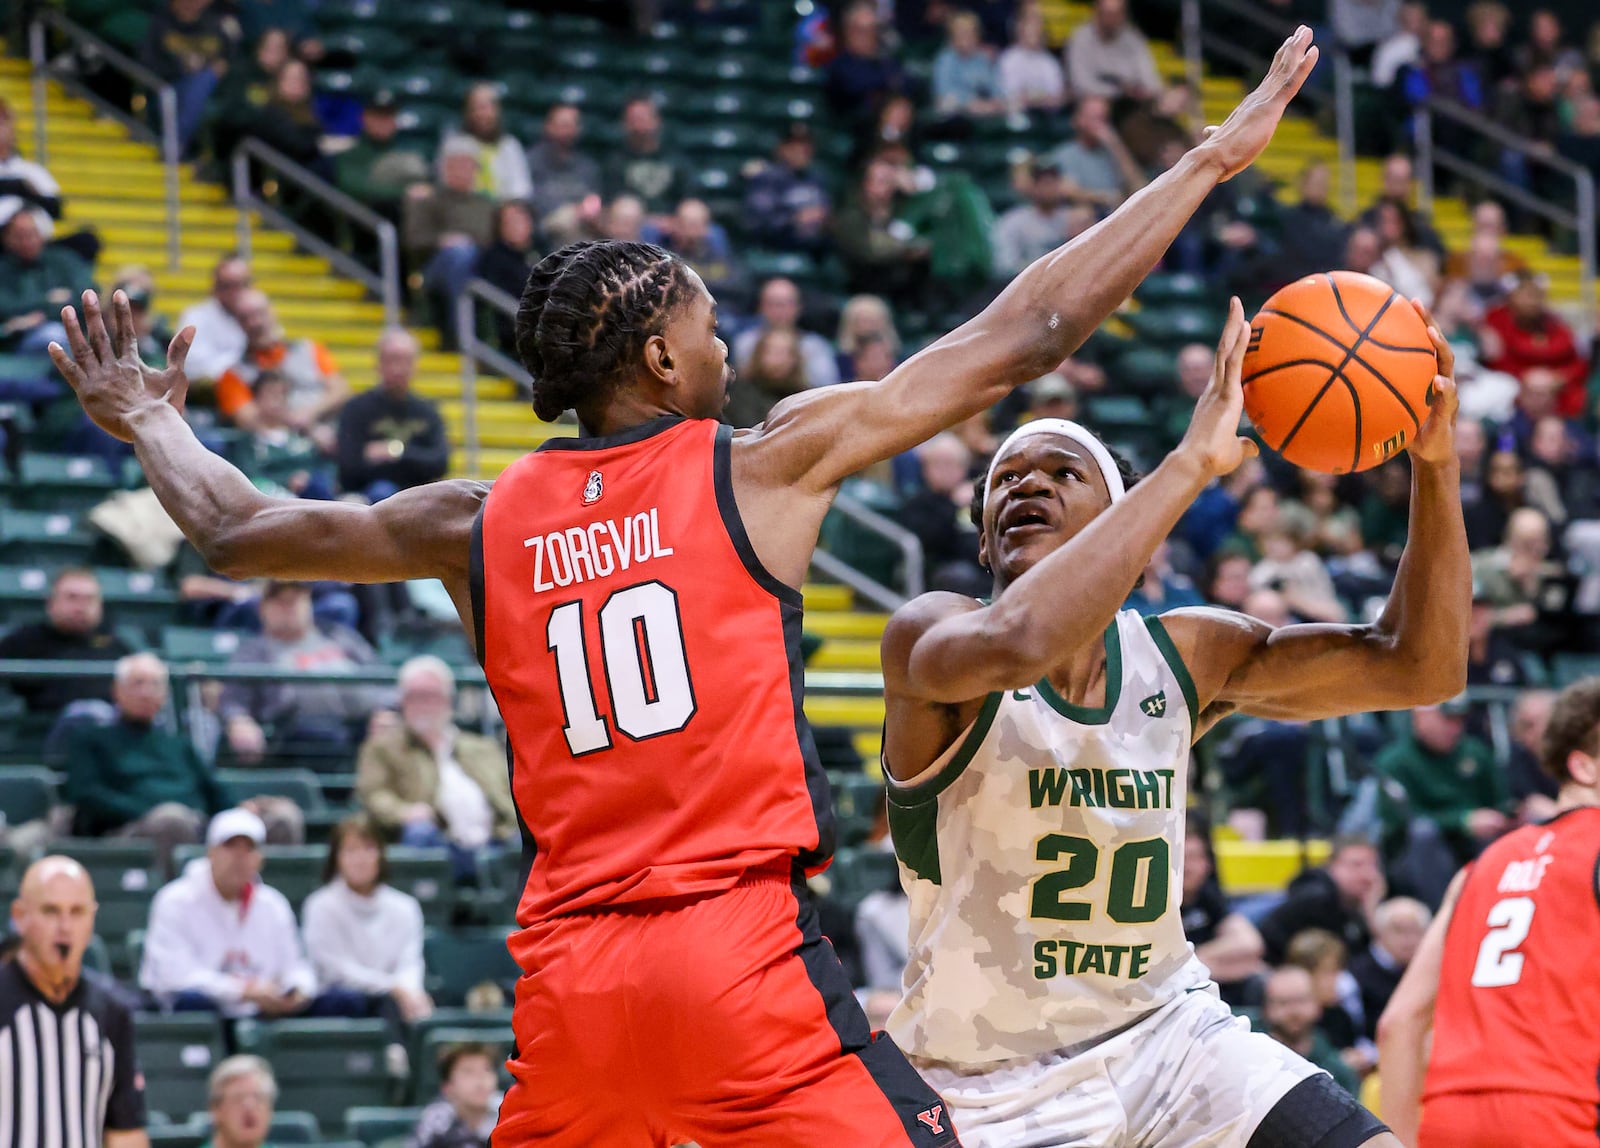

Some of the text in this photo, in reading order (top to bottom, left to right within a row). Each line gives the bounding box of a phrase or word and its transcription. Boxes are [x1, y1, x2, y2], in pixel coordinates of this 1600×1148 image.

[523, 507, 674, 593] ZORGVOL
[546, 578, 698, 758] 10
[1028, 768, 1176, 810] WRIGHT
[1028, 831, 1171, 926] 20
[1033, 938, 1153, 981] STATE
[1471, 896, 1536, 988] 2
[916, 1104, 945, 1135] Y
